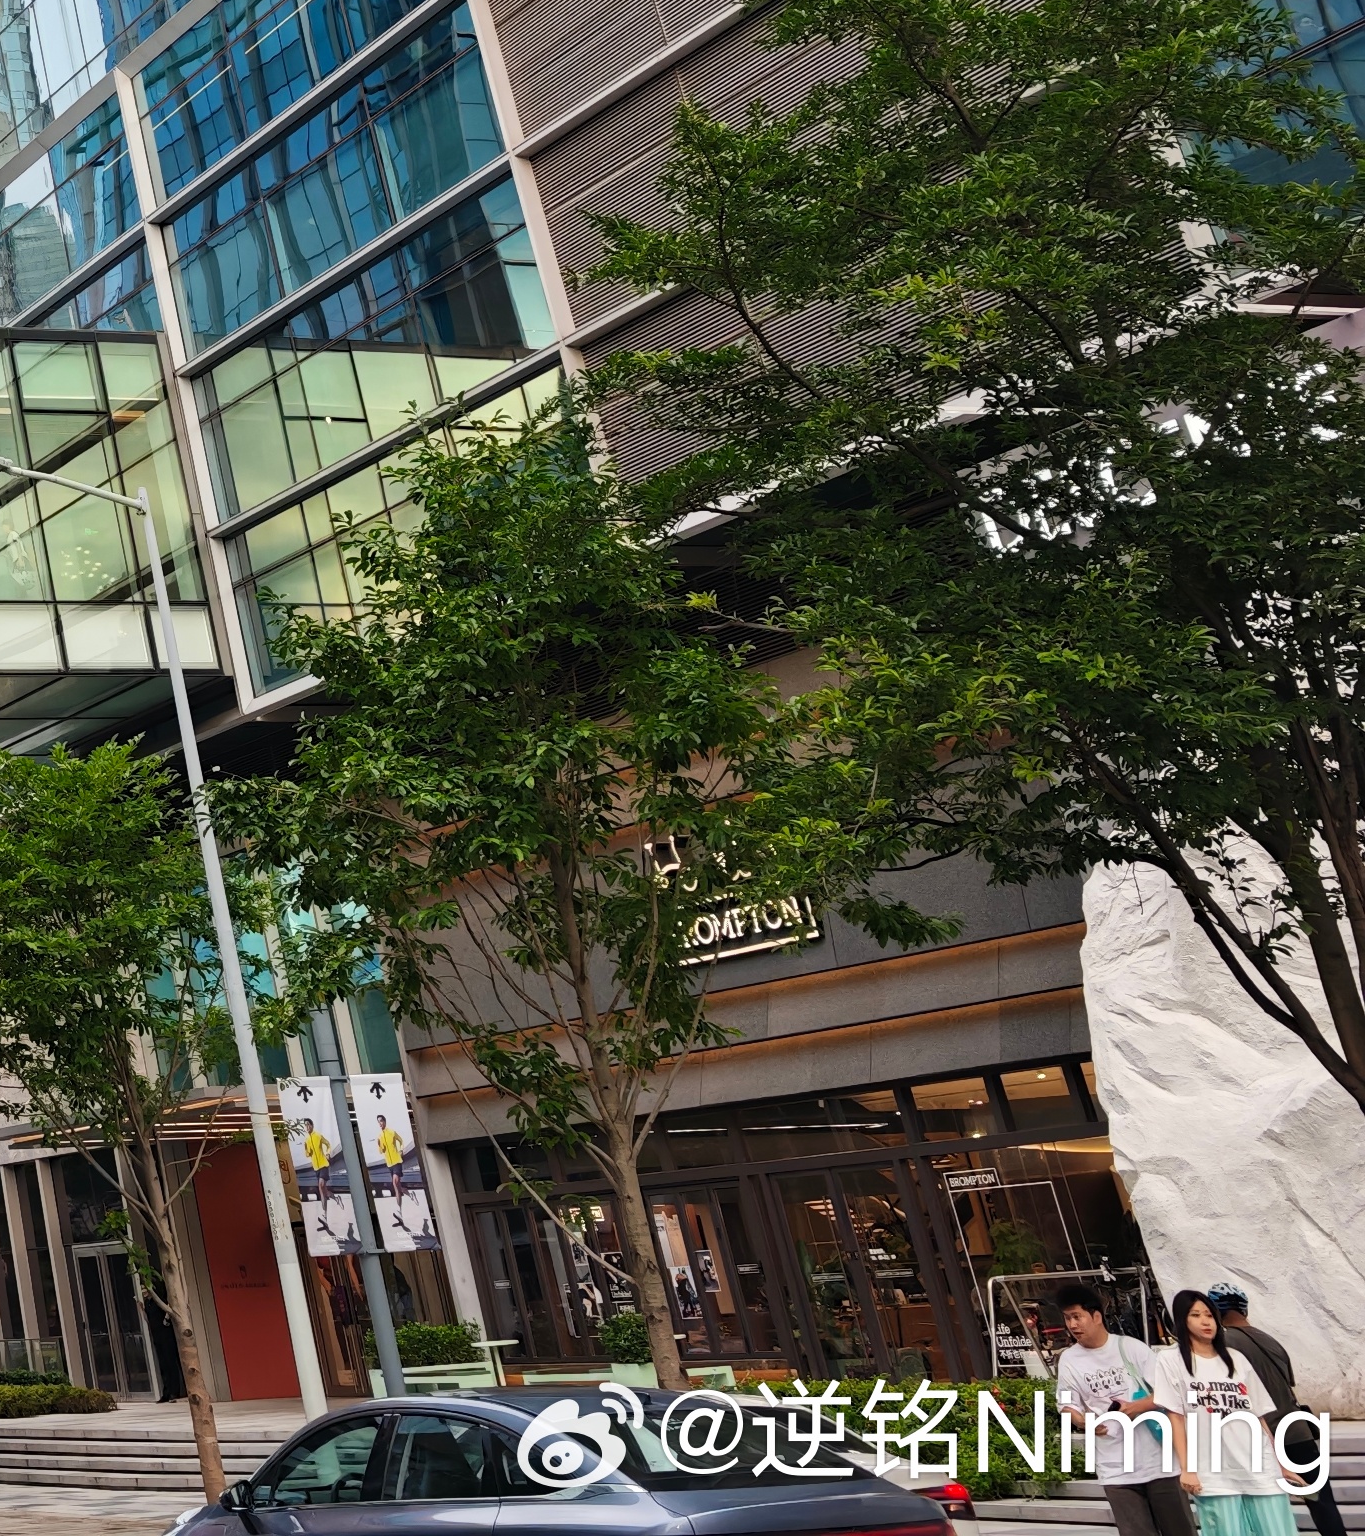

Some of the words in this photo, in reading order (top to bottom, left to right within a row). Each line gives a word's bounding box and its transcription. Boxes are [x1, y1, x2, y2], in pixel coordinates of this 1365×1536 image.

[673, 895, 804, 949] OMPTON
[948, 1173, 996, 1188] BROMPTON
[995, 1335, 1033, 1348] Unfolde
[1220, 1393, 1251, 1410] like
